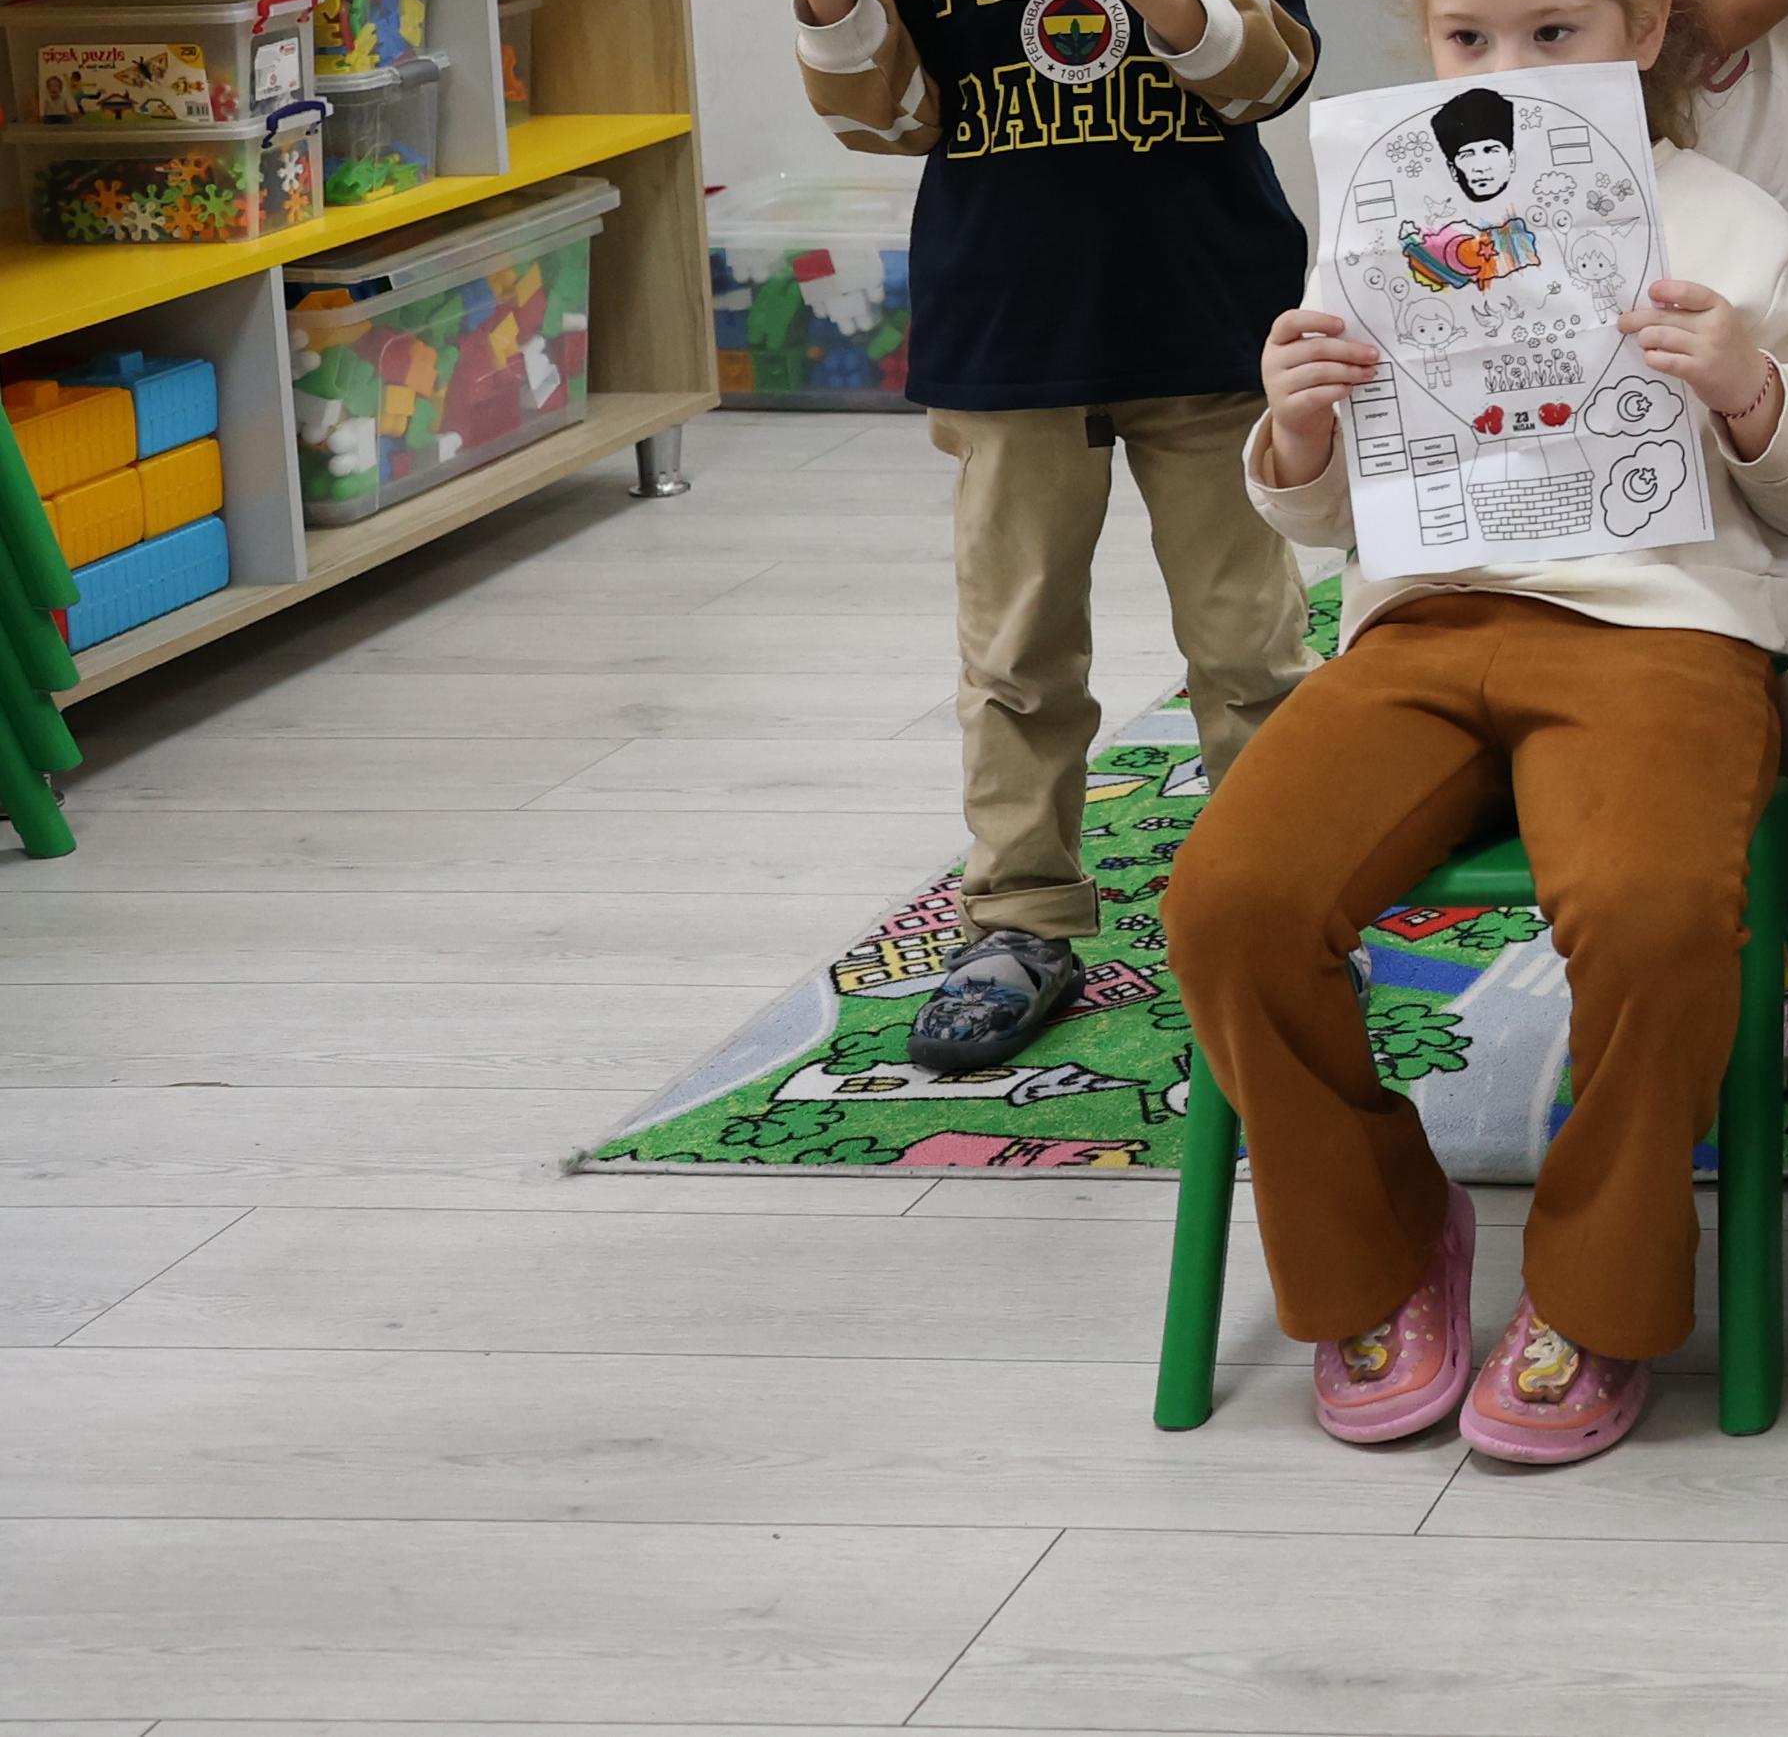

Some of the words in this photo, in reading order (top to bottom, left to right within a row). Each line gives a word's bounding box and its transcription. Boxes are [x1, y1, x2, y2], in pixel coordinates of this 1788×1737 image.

[1110, 3, 1128, 59] KULÜBÜ
[81, 47, 125, 65] puzzle
[1060, 68, 1092, 81] 1907
[1515, 411, 1529, 423] 23
